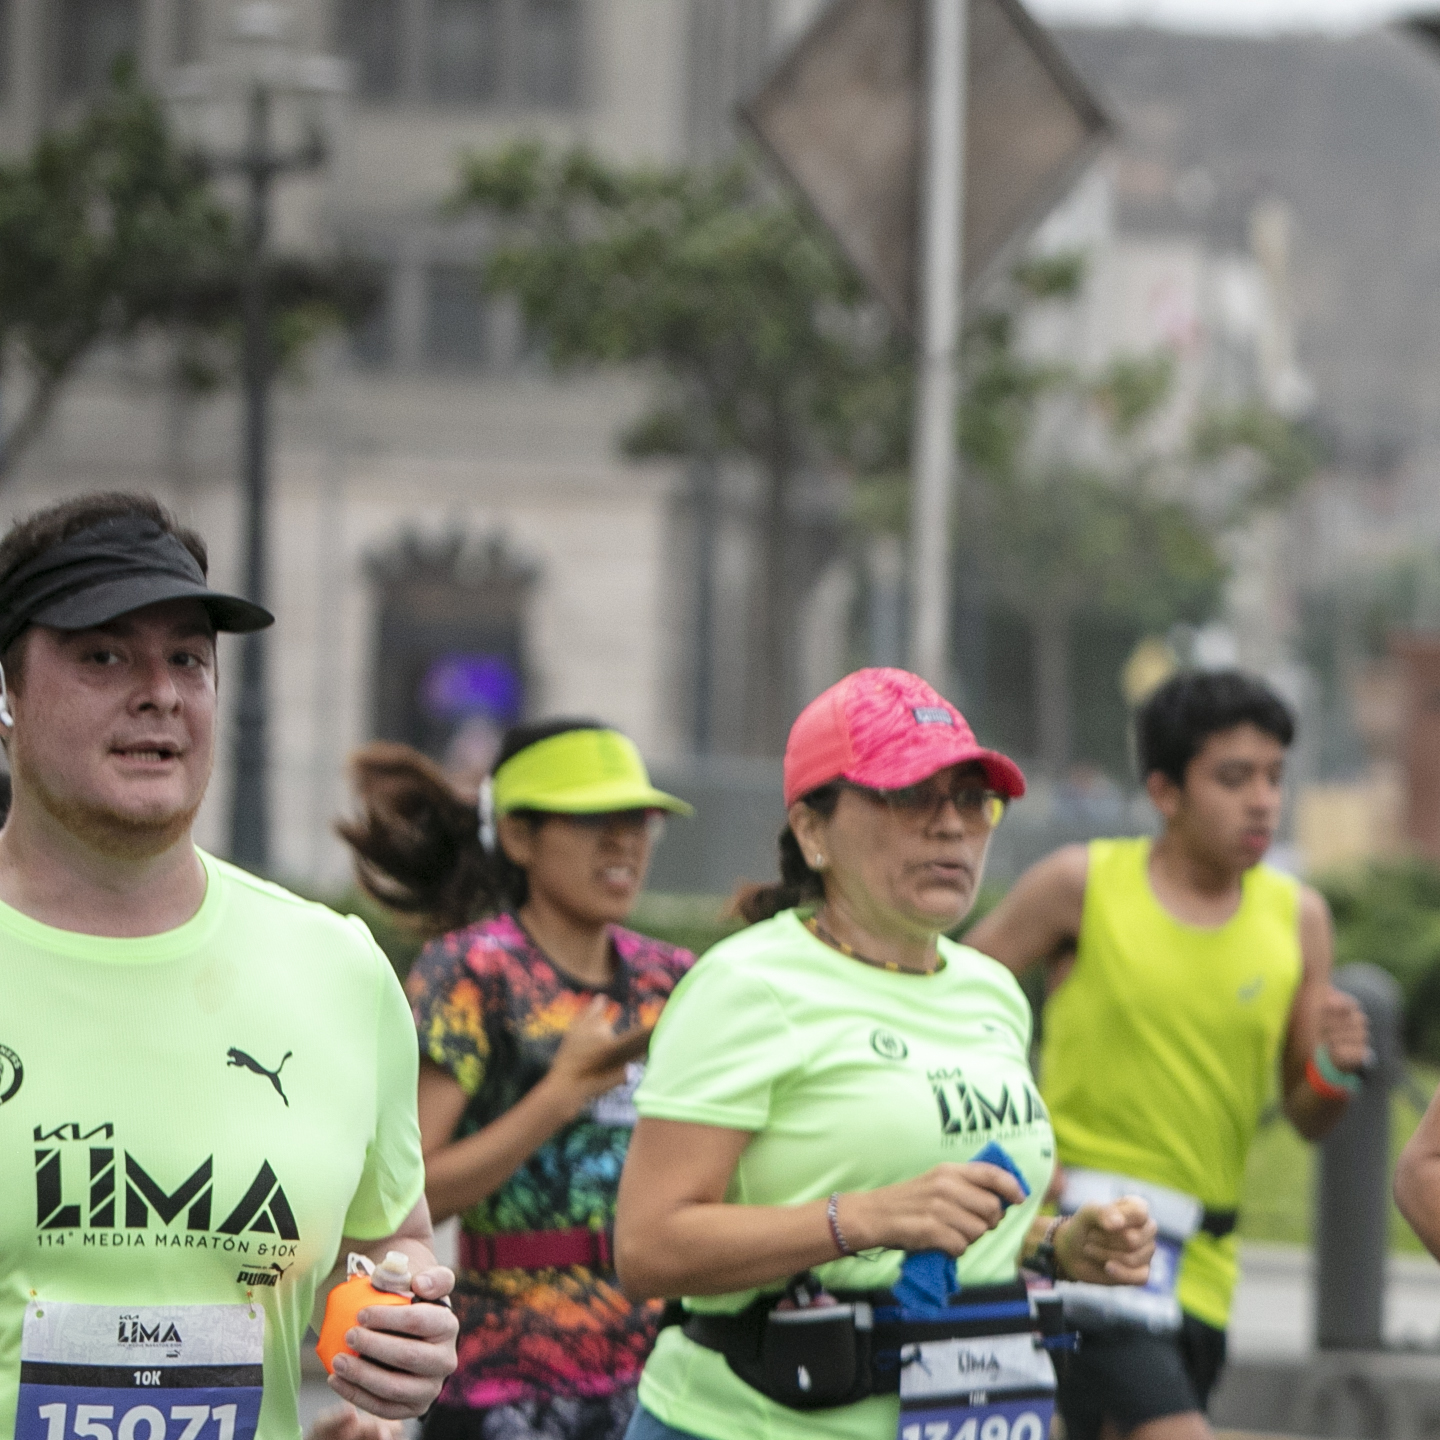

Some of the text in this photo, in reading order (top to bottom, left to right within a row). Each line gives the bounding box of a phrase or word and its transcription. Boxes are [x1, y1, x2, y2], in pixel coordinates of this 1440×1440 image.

[34, 1146, 300, 1240] LIMA
[83, 1232, 146, 1247] MEDIA
[155, 1233, 250, 1253] MARATÓN
[257, 1243, 297, 1257] &10K
[236, 1270, 278, 1287] PUMA
[117, 1322, 182, 1343] LIMA
[133, 1371, 161, 1385] 10K
